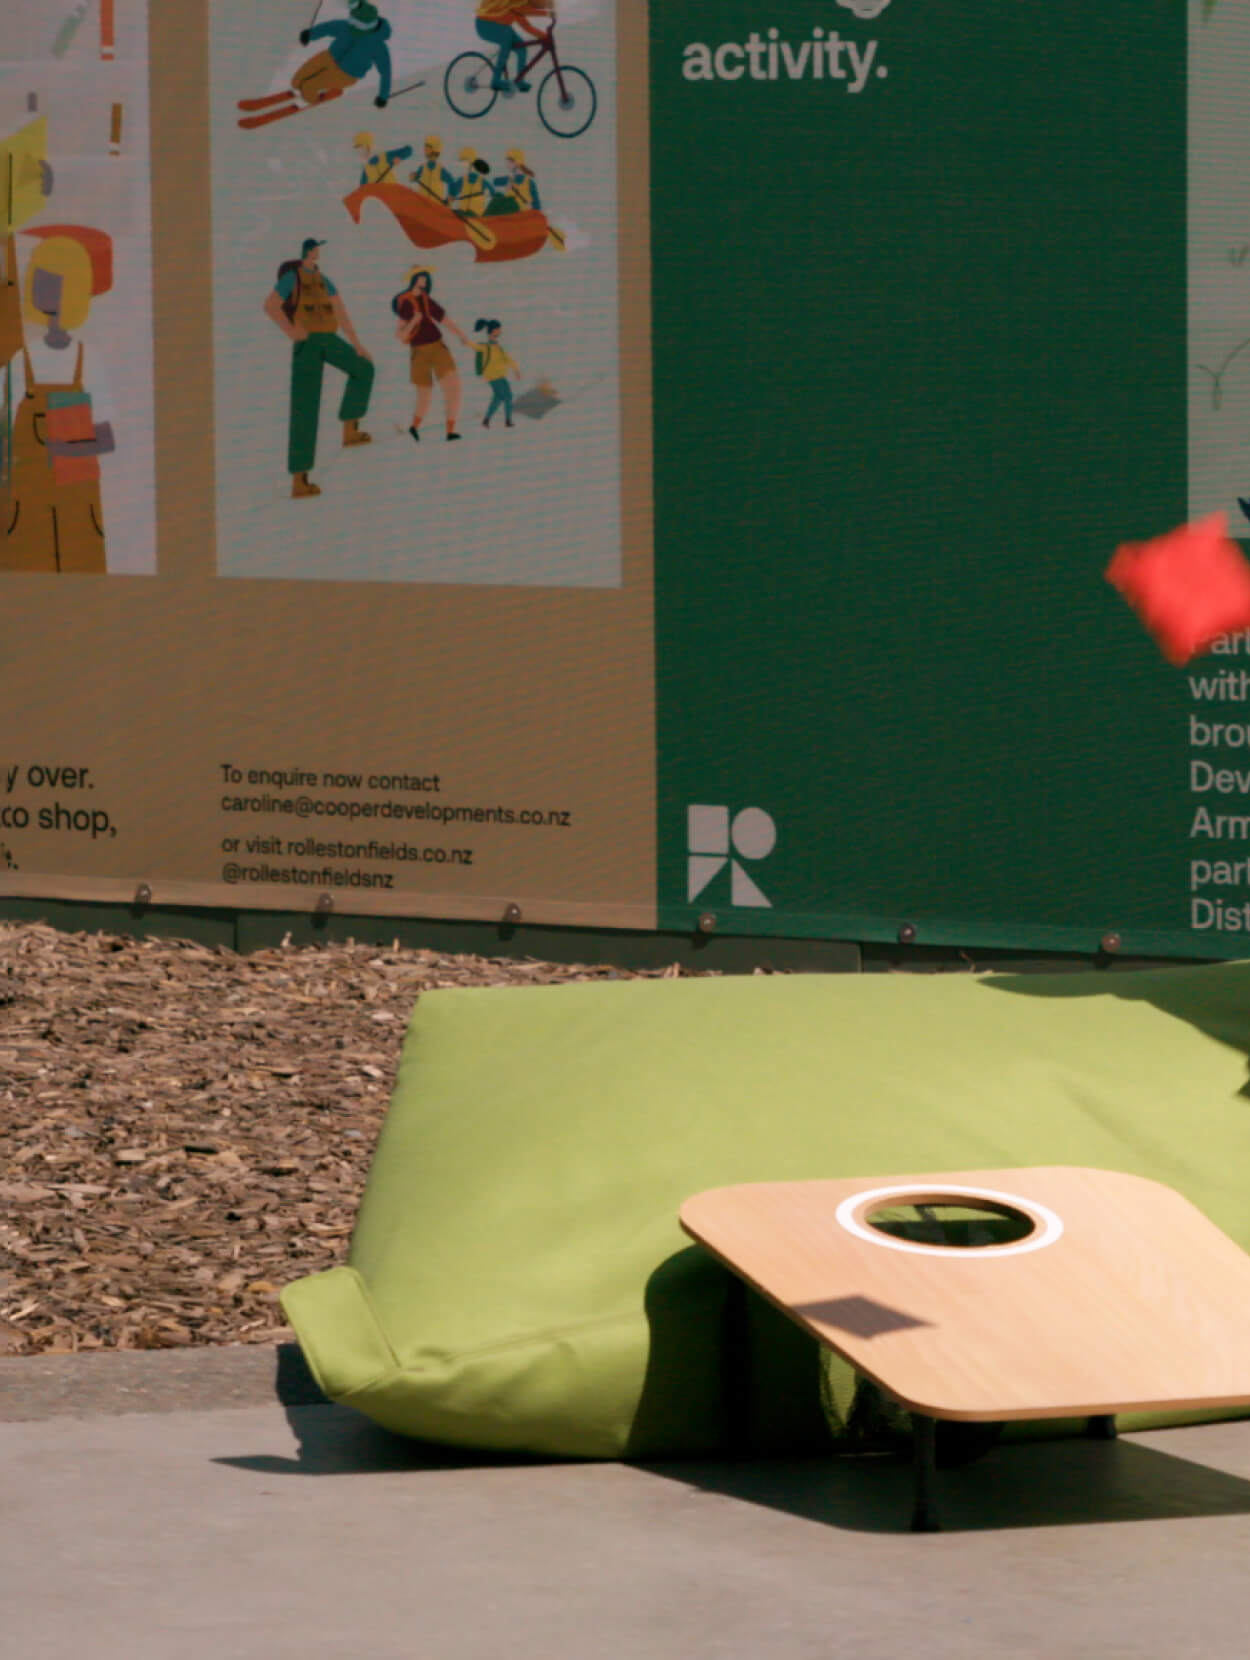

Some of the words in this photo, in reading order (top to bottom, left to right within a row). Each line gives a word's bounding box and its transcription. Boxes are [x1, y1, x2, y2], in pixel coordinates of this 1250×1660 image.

[682, 27, 888, 94] activity.
[27, 765, 95, 789] over.
[220, 764, 243, 784] To
[247, 767, 318, 790] enquire
[322, 772, 363, 788] now
[367, 773, 440, 792] contact
[38, 801, 118, 840] shop,
[221, 794, 571, 827] caroline@cooperdevelopments.co.nz
[221, 838, 241, 853] or
[246, 836, 282, 855] visit
[287, 837, 473, 865] rollestonfields.co.nz
[222, 862, 394, 889] @rollestonfieldsnz
